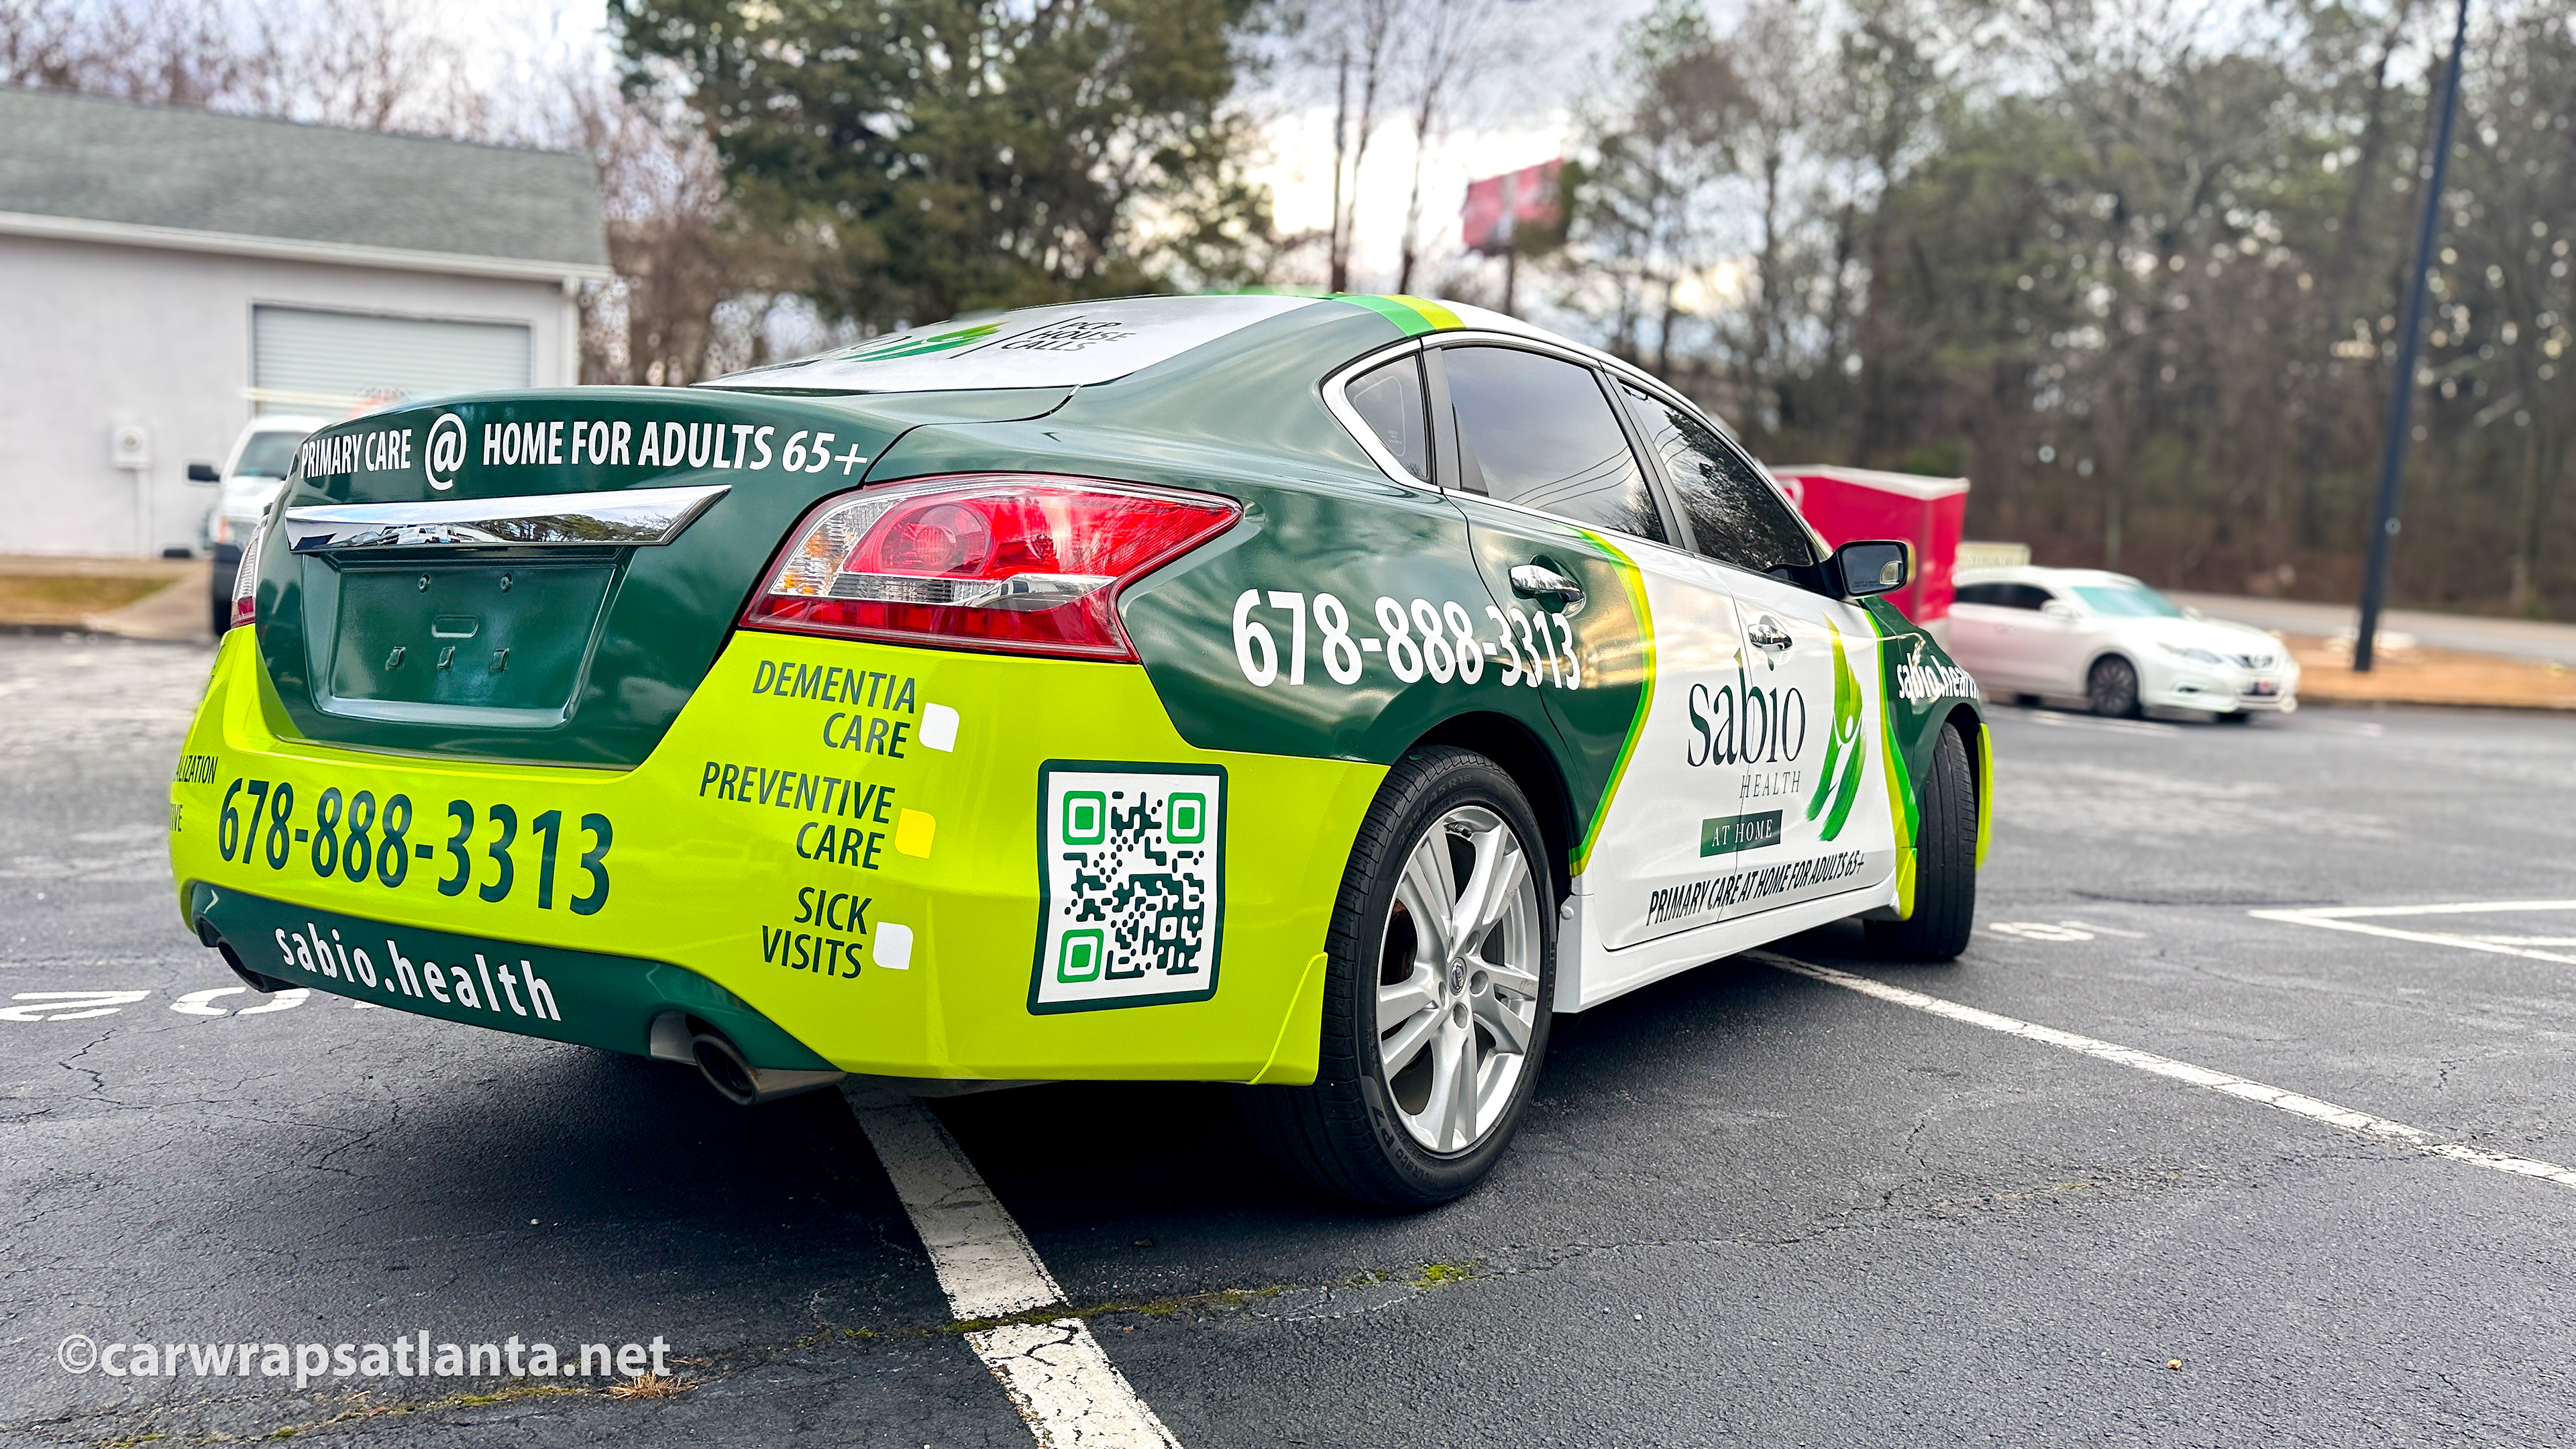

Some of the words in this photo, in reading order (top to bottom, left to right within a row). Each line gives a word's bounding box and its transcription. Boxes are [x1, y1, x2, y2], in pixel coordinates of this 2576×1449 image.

[1000, 339, 1096, 352] CALLS
[1030, 329, 1136, 341] HOUSE
[1059, 321, 1122, 331] PCP
[301, 427, 366, 479] PRIMARY
[364, 427, 412, 472] CARE
[425, 413, 467, 491] @
[483, 421, 563, 466] HOME
[572, 420, 631, 466] FOR
[639, 421, 774, 471] ADULTS
[782, 430, 868, 476] 65+
[1232, 588, 1581, 691] 678-888-3313
[752, 660, 916, 714] DEMENTIA
[1687, 647, 1806, 767] sabio
[823, 712, 910, 759] CARE
[700, 761, 896, 824] PREVENTIVE
[1739, 770, 1801, 799] HEALTH
[219, 777, 614, 916] 678-888-3313
[796, 821, 886, 871] CARE
[1711, 824, 1730, 847] AT
[1735, 818, 1773, 844] HOME
[794, 886, 873, 934] SICK
[1646, 879, 1711, 926] PRIMARY
[1707, 873, 1743, 910] CARE
[1737, 869, 1759, 903] AT
[1753, 863, 1789, 899] HOME
[1786, 857, 1812, 891] FOR
[1810, 850, 1848, 883] ADULTS
[1844, 849, 1866, 876] 65+
[276, 922, 562, 1022] sabio.health
[761, 924, 863, 979] VISITS
